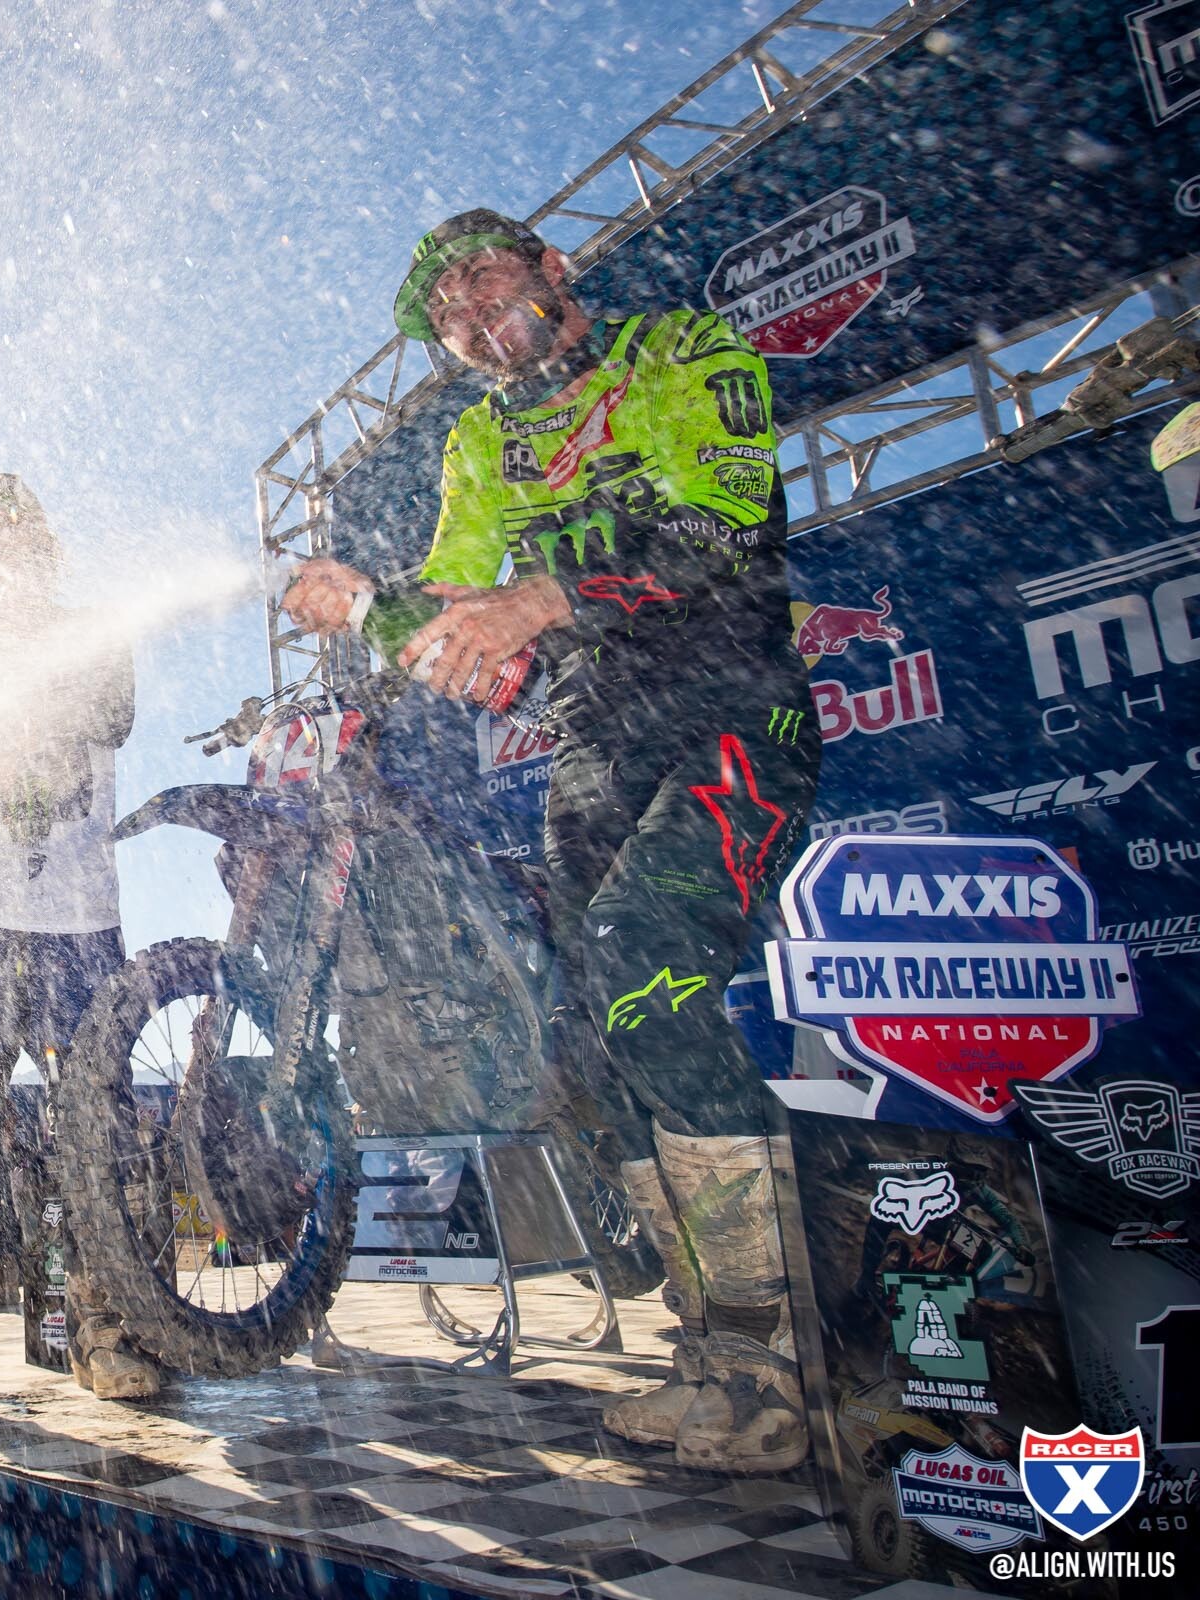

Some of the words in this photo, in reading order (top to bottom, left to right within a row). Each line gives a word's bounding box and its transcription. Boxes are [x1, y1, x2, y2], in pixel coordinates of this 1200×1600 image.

[724, 201, 863, 292] MAXXIS
[724, 302, 755, 326] OX
[756, 240, 879, 318] RACEWAY
[747, 285, 868, 343] NATIONAL
[720, 464, 763, 481] TEAM
[679, 536, 753, 560] ENERGY
[810, 651, 941, 742] Bull
[1042, 684, 1166, 735] CH
[487, 774, 518, 796] OIL
[522, 762, 553, 786] PRO
[990, 761, 1158, 816] FLY
[1011, 796, 1121, 824] RACING
[1163, 840, 1200, 863] Hu
[840, 873, 1061, 918] MAXXIS
[812, 956, 892, 999] FOX
[894, 956, 1087, 1000] RACEWAY
[1089, 957, 1117, 1000] II
[882, 1024, 1069, 1041] NATIONAL
[936, 1060, 1027, 1073] CALIFORNIA
[960, 1049, 1000, 1060] PALA
[868, 1162, 930, 1171] PRESENTED
[932, 1161, 949, 1170] BY
[1114, 1156, 1136, 1174] FOX
[1138, 1154, 1193, 1172] RACEWAY
[444, 1232, 480, 1249] ND
[42, 1327, 66, 1335] MOTOC
[907, 1379, 936, 1395] PALA
[938, 1382, 969, 1397] BAND
[971, 1385, 986, 1399] OF
[901, 1394, 949, 1410] MISSION
[952, 1398, 999, 1415] INDIANS
[915, 1459, 974, 1482] LUCAS
[977, 1467, 1008, 1486] OIL
[1139, 1468, 1199, 1505] irst
[903, 1501, 1036, 1525] CHAMPIONSHIP
[1138, 1516, 1189, 1532] 450
